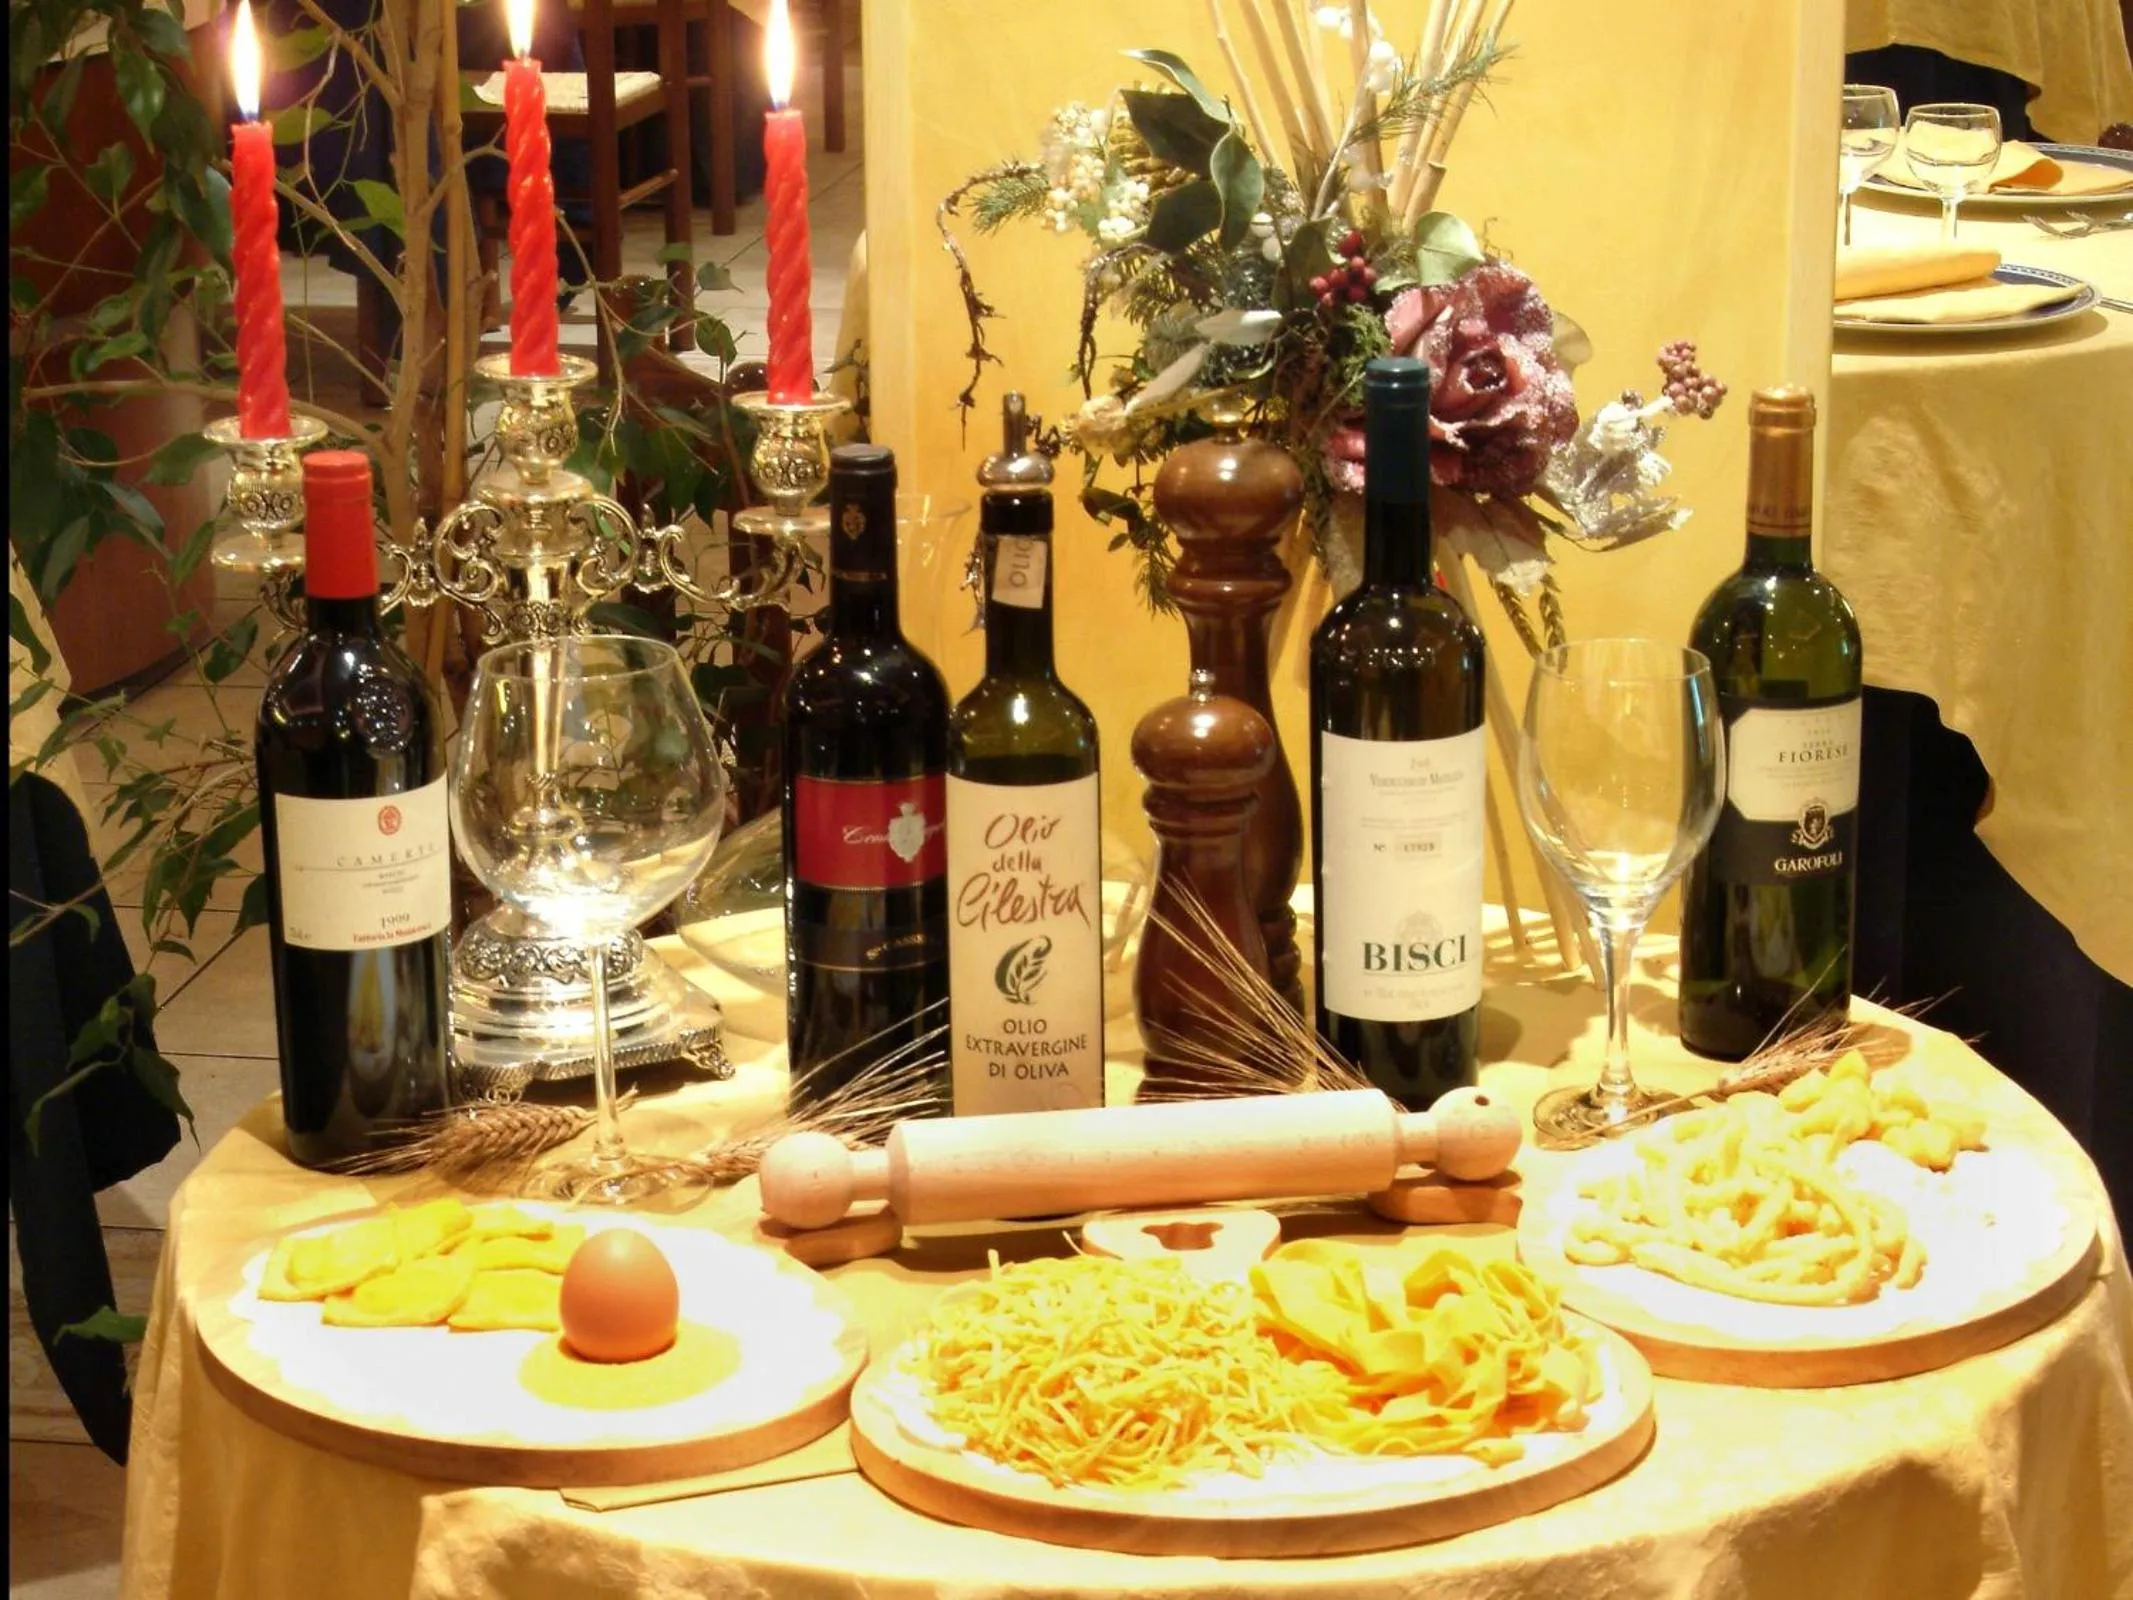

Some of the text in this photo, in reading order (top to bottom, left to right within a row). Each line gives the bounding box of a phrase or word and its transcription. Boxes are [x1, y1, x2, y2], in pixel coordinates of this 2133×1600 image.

[991, 849, 1043, 873] della
[1362, 934, 1467, 972] BISCI
[1003, 1018, 1048, 1035] OLIO
[966, 1034, 1088, 1058] EXTRAVERGINE
[988, 1062, 1070, 1081] DI OLIVA
